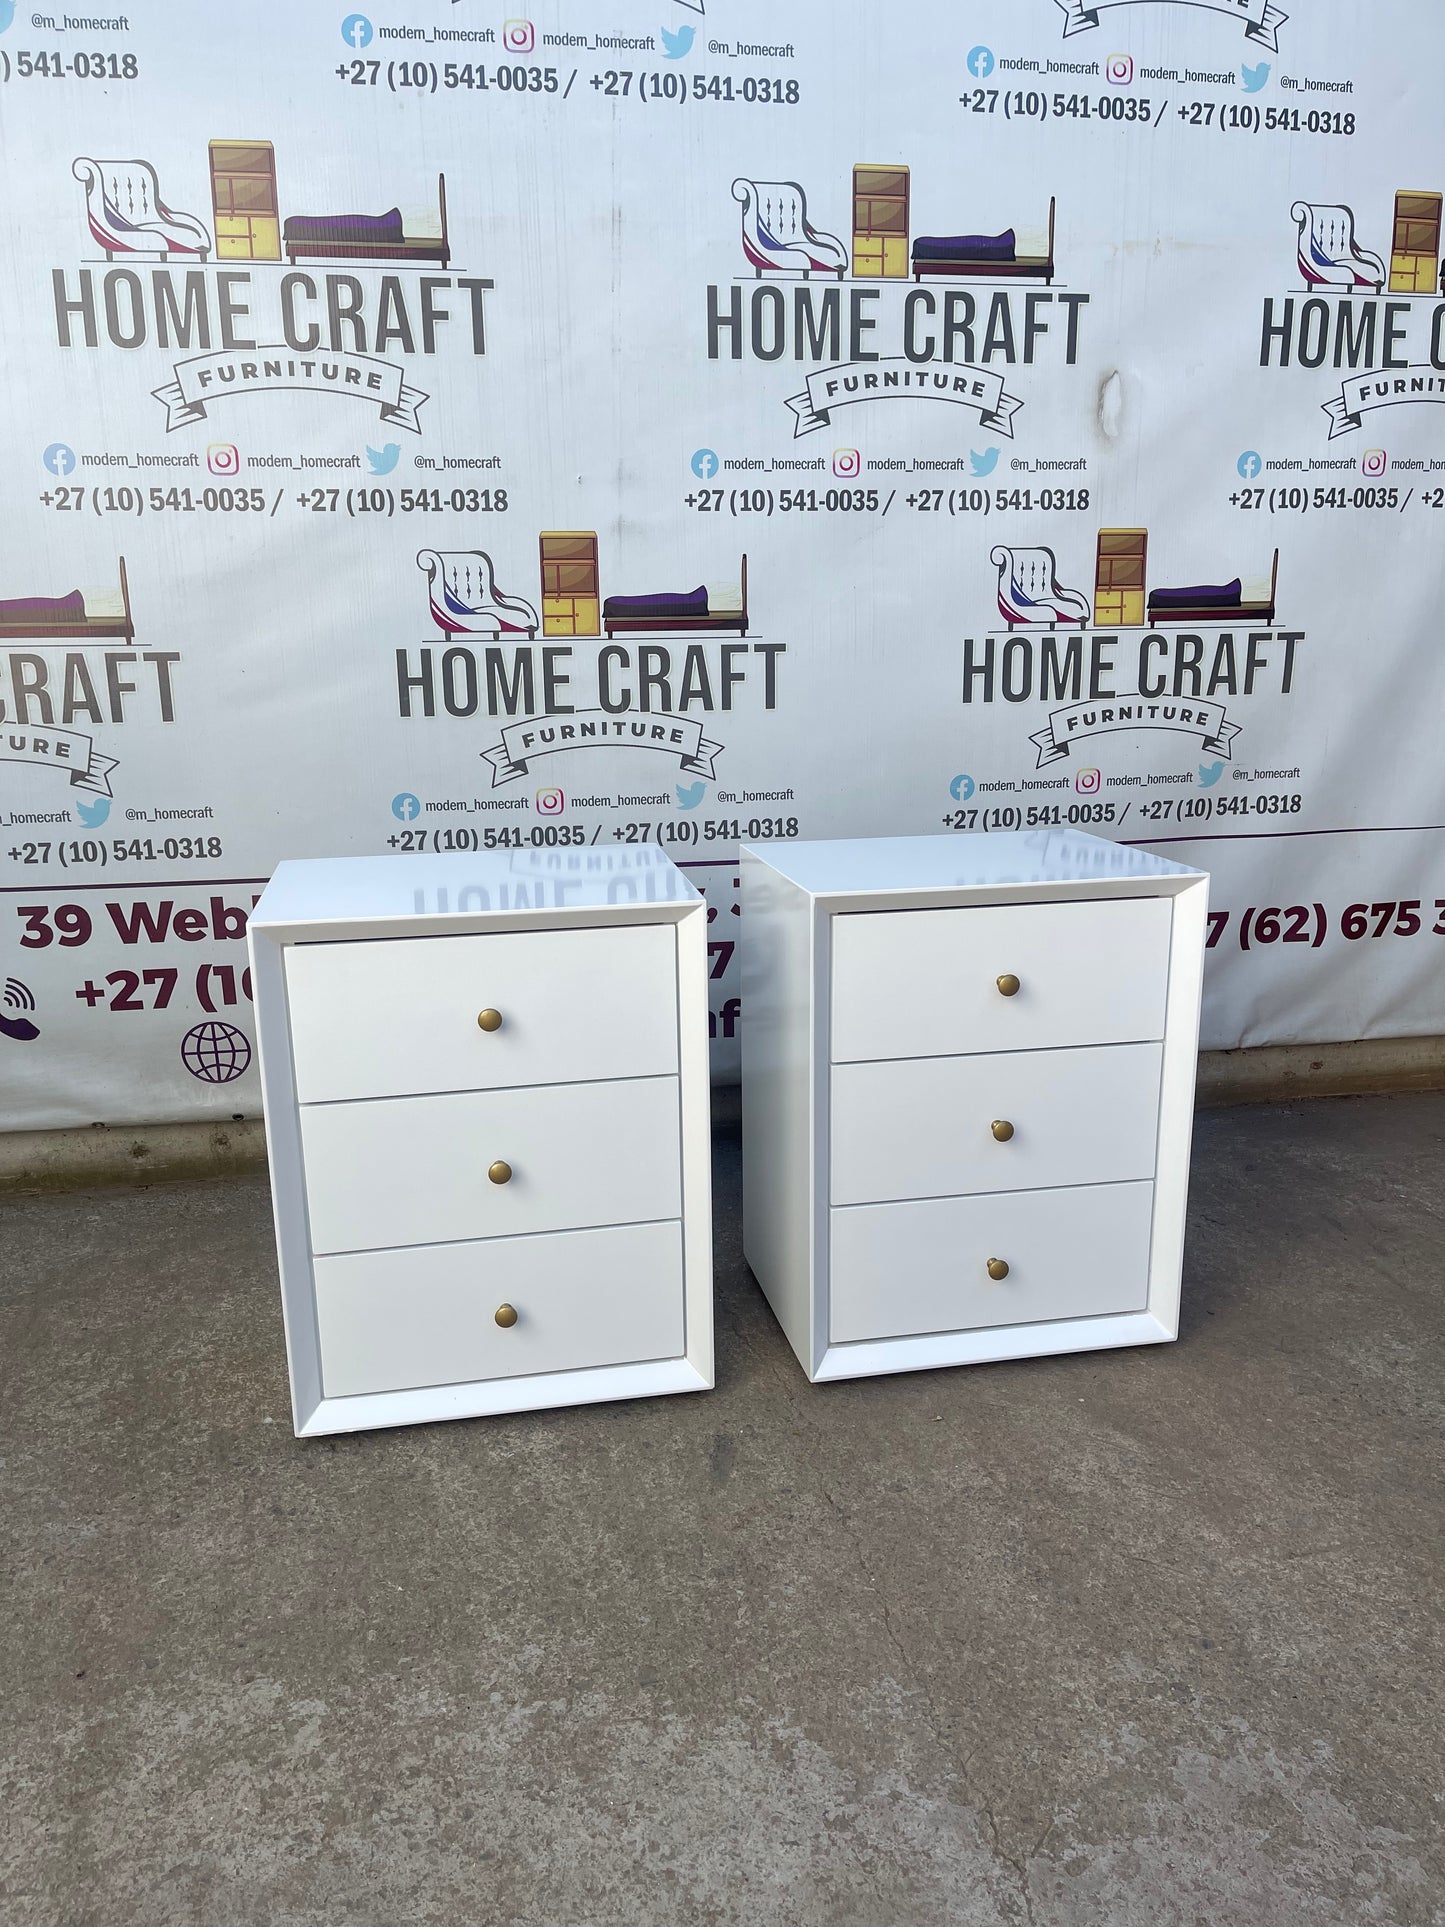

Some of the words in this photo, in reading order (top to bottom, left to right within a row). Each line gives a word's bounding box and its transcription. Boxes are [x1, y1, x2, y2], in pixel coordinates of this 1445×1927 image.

[31, 13, 129, 31] @m_homecraft
[379, 24, 496, 44] modern_homecraft
[543, 32, 655, 51] modern_homecraft
[708, 39, 794, 58] @m_homecraft
[17, 51, 138, 79] 541-0318
[1000, 56, 1099, 75] modern_homecraft
[1140, 65, 1235, 85] modern_homecraft
[1280, 75, 1353, 94] @m_homecraft
[335, 60, 380, 86] +27
[387, 61, 438, 93] (10)
[444, 63, 558, 93] 541-0035
[590, 70, 633, 96] +27
[639, 72, 688, 104] (10)
[692, 75, 800, 104] 541-0318
[959, 88, 999, 114] +27
[1004, 91, 1047, 120] (10)
[1052, 93, 1151, 122] 541-0035
[1177, 103, 1215, 126] +27
[1220, 104, 1260, 133] (10)
[1265, 107, 1355, 135] 541-0318
[52, 269, 257, 351] HOME
[280, 272, 494, 356] CRAFT
[707, 285, 880, 362] HOME
[904, 289, 1090, 365] CRAFT
[1260, 298, 1411, 369] HOME
[198, 360, 382, 390] FURNITURE
[826, 371, 985, 398] FURNITURE
[1359, 377, 1445, 401] FURNIT
[82, 451, 199, 470] modern_homecraft
[247, 453, 360, 471] modern_homecraft
[414, 454, 501, 472] @m_homecraft
[724, 457, 825, 473] modern_homecraft
[867, 458, 964, 473] modern_homecraft
[1010, 457, 1087, 473] @m_homecraft
[1266, 458, 1356, 471] modern_homecraft
[39, 487, 85, 512] +27
[92, 487, 143, 517] (10)
[149, 487, 264, 512] 541-0035
[297, 488, 340, 513] +27
[347, 488, 395, 517] (10)
[400, 488, 508, 512] 541-0318
[685, 490, 725, 511] +27
[730, 490, 774, 516] (10)
[779, 489, 879, 511] 541-0035
[905, 489, 944, 511] +27
[949, 489, 991, 515] (10)
[996, 489, 1089, 511] 541-0318
[1229, 488, 1265, 509] +27
[1269, 488, 1308, 513] (10)
[1313, 487, 1398, 509] 541-0035
[1421, 488, 1445, 509] +2
[396, 646, 575, 718] HOME
[599, 643, 786, 713] CRAFT
[963, 636, 1118, 703] HOME
[1138, 632, 1305, 698] CRAFT
[0, 652, 180, 725] RAFT
[1067, 705, 1209, 732] FURNITURE
[522, 722, 684, 748] FURNITURE
[979, 777, 1070, 793] modern_homecraft
[1106, 772, 1193, 788] modern_homecraft
[1232, 767, 1300, 782] @m_homecraft
[126, 806, 213, 822] @m_homecraft
[425, 797, 529, 814] modern_homecraft
[571, 792, 671, 809] modern_homecraft
[717, 788, 794, 805] @m_homecraft
[942, 809, 978, 830] +27
[982, 807, 1022, 832] (10)
[1026, 802, 1115, 825] 541-0035
[1139, 800, 1174, 821] +27
[1177, 798, 1212, 821] (10)
[1217, 794, 1301, 816] 541-0318
[387, 830, 428, 851] +27
[433, 828, 478, 852] (10)
[483, 825, 585, 849] 541-0035
[612, 822, 651, 844] +27
[656, 821, 699, 847] (10)
[704, 818, 798, 841] 541-0318
[8, 842, 51, 864] +27
[59, 841, 107, 867] (10)
[113, 837, 222, 862] 541-0318
[17, 904, 92, 948] 39
[105, 895, 261, 944] Web
[76, 968, 178, 1012] +27
[1240, 902, 1328, 950] (62)
[1341, 900, 1421, 940] 675
